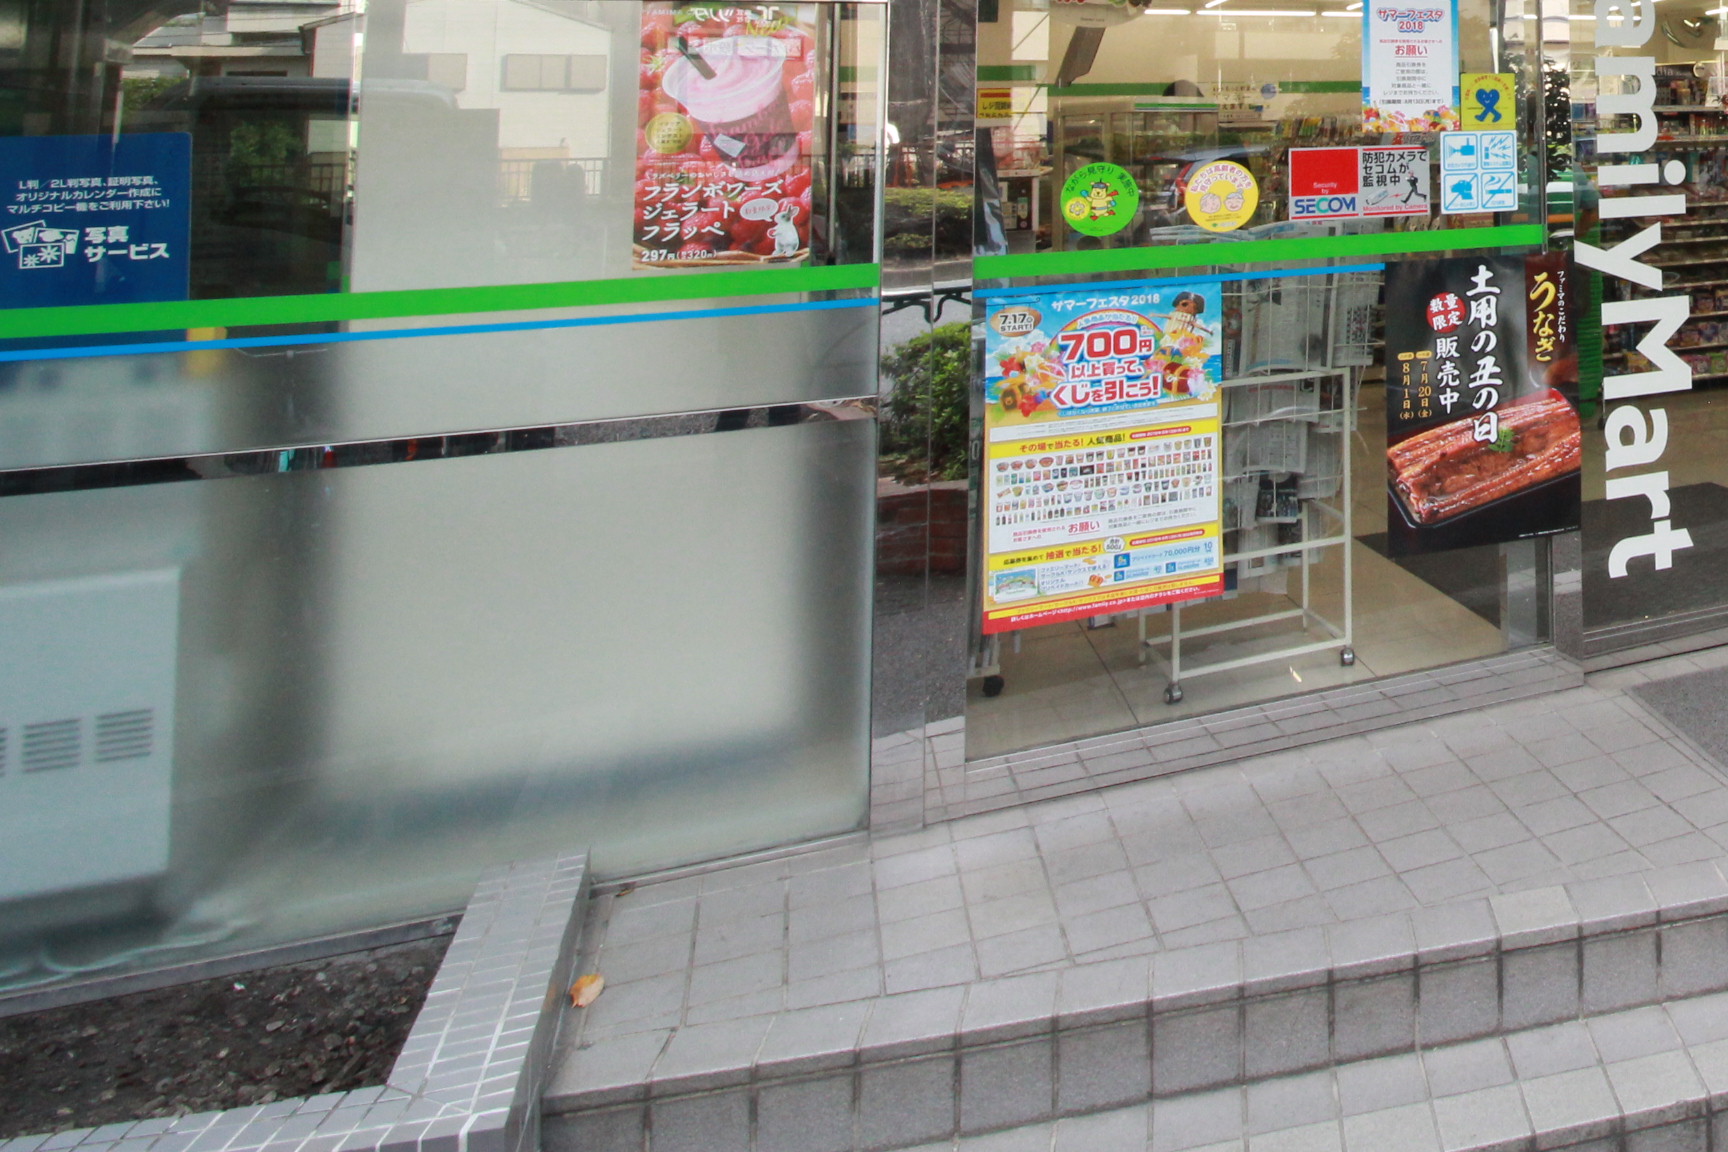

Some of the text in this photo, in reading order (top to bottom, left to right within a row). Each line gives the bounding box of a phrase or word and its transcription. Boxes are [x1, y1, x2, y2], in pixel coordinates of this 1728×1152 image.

[1378, 9, 1444, 21] サマーフェスタ
[1399, 21, 1424, 31] 2018
[1394, 44, 1428, 56] お願い
[1362, 150, 1427, 164] 防犯カメラで
[1363, 162, 1410, 175] セコムが
[643, 180, 784, 202] フランボワーズ
[1313, 182, 1337, 190] Security
[1362, 176, 1400, 188] 監視中
[15, 188, 162, 202] オリジナルカレンダー作成に
[643, 201, 735, 221] ジェラート
[1294, 197, 1356, 214] SECOM
[84, 226, 129, 243] 写真
[642, 222, 725, 242] フラッペ
[84, 243, 170, 262] サービス
[1051, 293, 1160, 312] サマーフェスタ2018
[1429, 293, 1461, 314] 数量
[1556, 270, 1567, 344] ファミマのこだわり
[1000, 312, 1027, 325] 7.17
[1432, 311, 1463, 331] 限定
[1529, 271, 1556, 362] うなぎ
[1000, 322, 1034, 333] START!
[1060, 328, 1154, 362] 700円
[1466, 264, 1503, 444] 土用の丑の日
[1071, 359, 1144, 379] 以上買って、
[1436, 336, 1461, 414] 販売中
[1053, 376, 1160, 406] くじを引こう!
[1400, 362, 1415, 419] 8月1日(水)
[1417, 361, 1433, 417] 7月20日(金)
[1019, 438, 1085, 453] その場で当たる!
[1068, 521, 1100, 534] お願い
